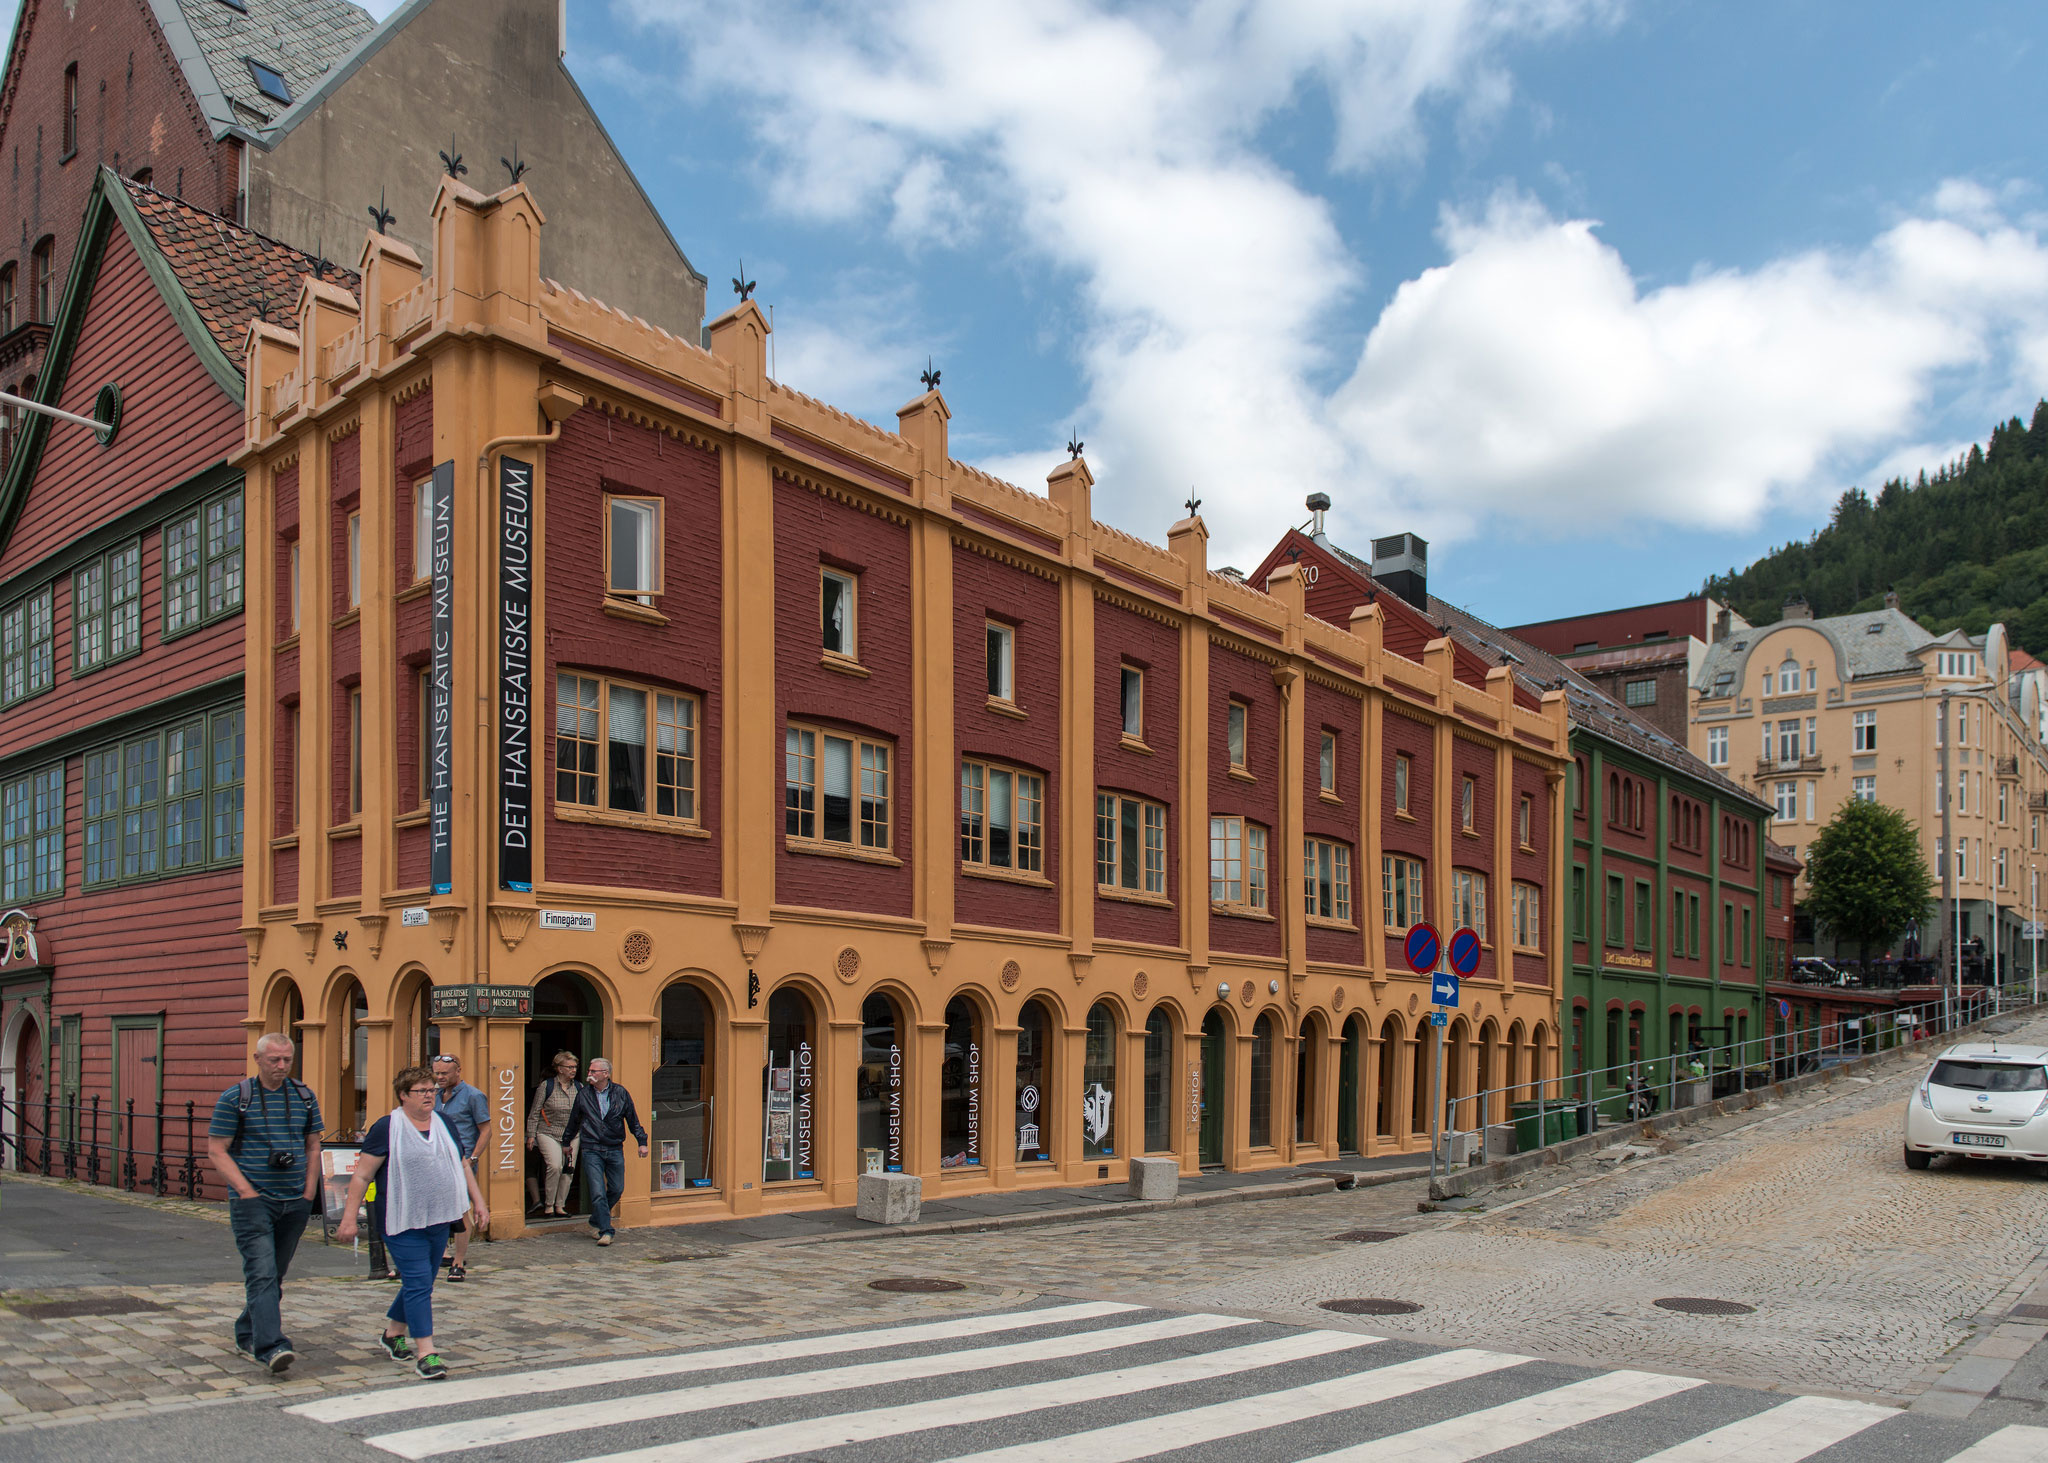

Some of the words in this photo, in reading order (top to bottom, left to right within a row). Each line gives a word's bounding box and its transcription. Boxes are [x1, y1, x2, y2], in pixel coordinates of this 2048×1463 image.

[505, 468, 528, 593] MUSEUM
[435, 495, 450, 618] MUSEUM
[434, 631, 449, 789] HANSEATIC
[505, 600, 527, 788] HANSEATISKE
[434, 801, 448, 852] THE
[505, 797, 527, 848] DET
[545, 912, 592, 928] Finnegården
[440, 988, 469, 998] HANSEATISKE
[441, 998, 458, 1007] MUSEUM
[476, 988, 489, 997] DET
[491, 989, 531, 998] HANSEATISKE
[492, 998, 517, 1007] MUSEUM
[800, 1041, 812, 1087] SHOP
[890, 1044, 901, 1087] SHOP
[969, 1043, 980, 1083] SHOP
[500, 1069, 515, 1170] INNGANG
[968, 1088, 979, 1153] MUSEUM
[1191, 1070, 1200, 1122] KONTOR
[799, 1092, 811, 1166] MUSEUM
[889, 1092, 901, 1161] MUSEUM
[1961, 1134, 1971, 1143] EL
[1975, 1135, 2001, 1145] 31476
